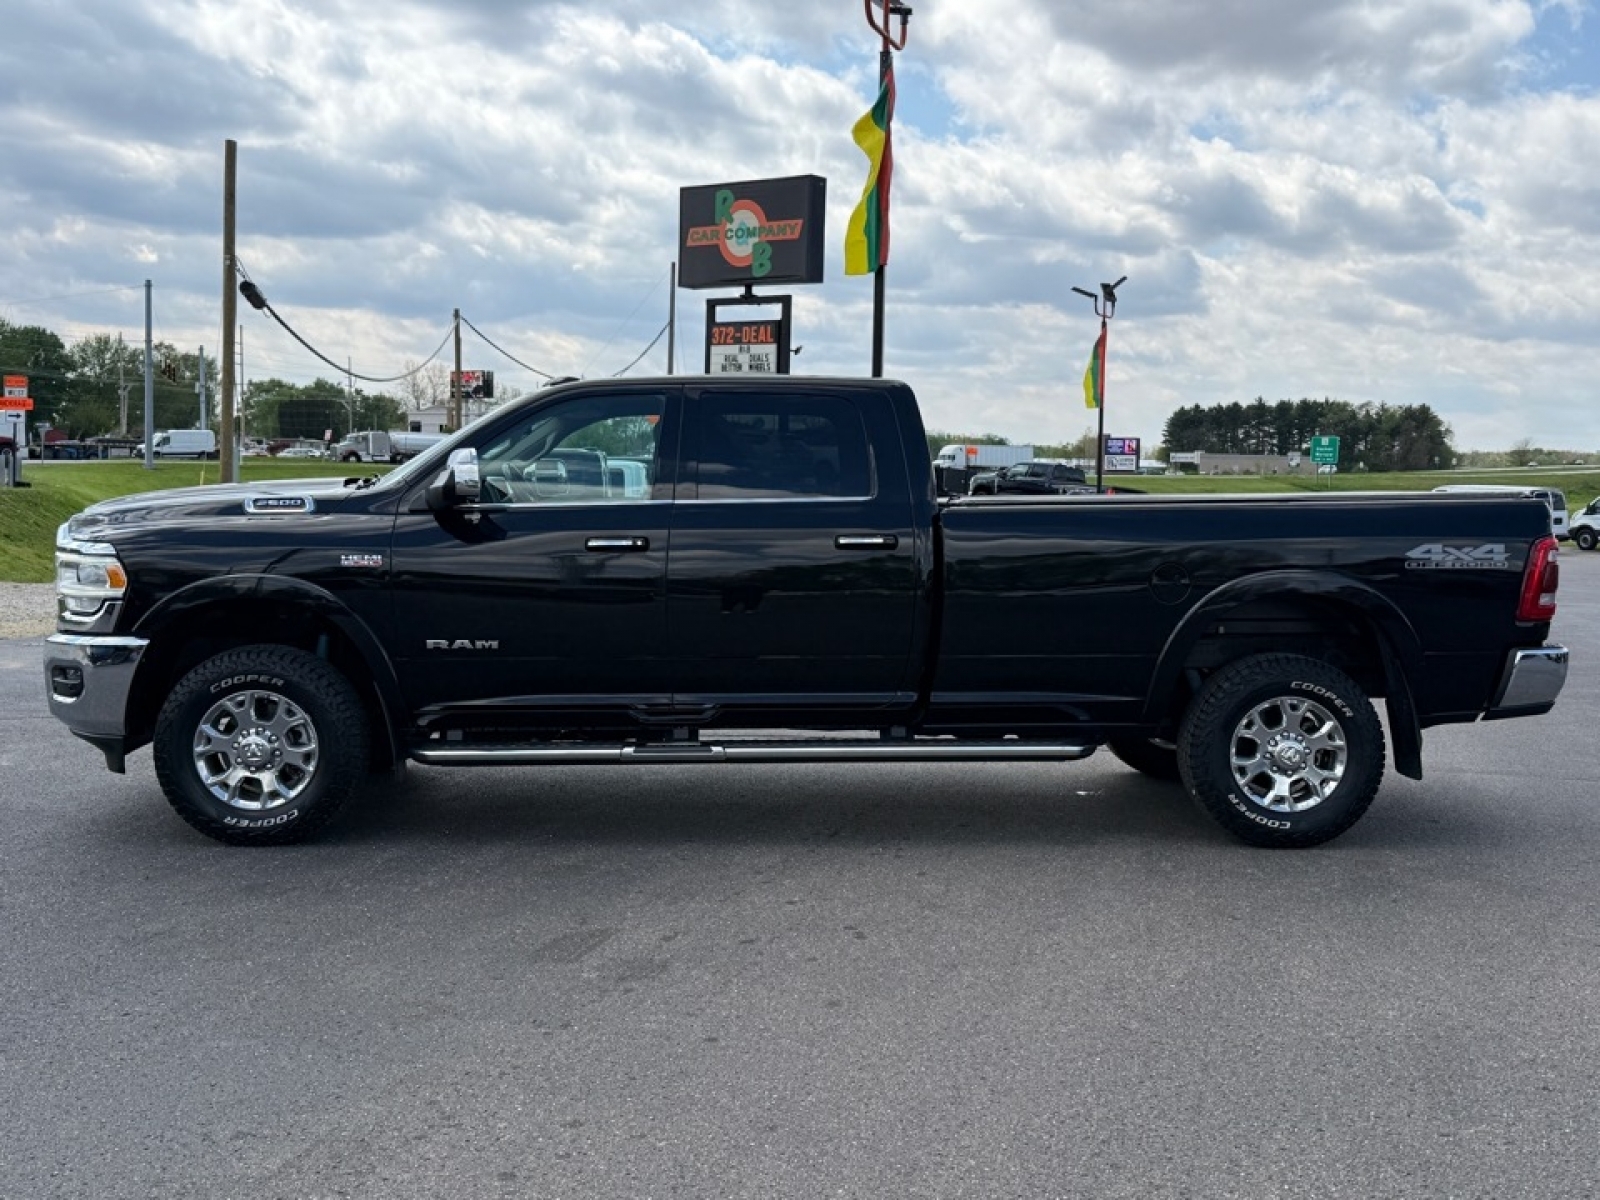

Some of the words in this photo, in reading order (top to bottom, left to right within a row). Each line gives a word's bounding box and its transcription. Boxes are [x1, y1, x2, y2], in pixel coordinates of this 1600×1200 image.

[689, 229, 720, 242] CAR
[724, 222, 798, 240] COMPANY
[711, 325, 774, 344] 372-DEAL
[426, 639, 499, 649] RAM
[209, 674, 285, 694] COOPER
[1290, 680, 1354, 718] COOPER
[223, 809, 299, 828] COOPER
[1227, 793, 1291, 829] COOPER
